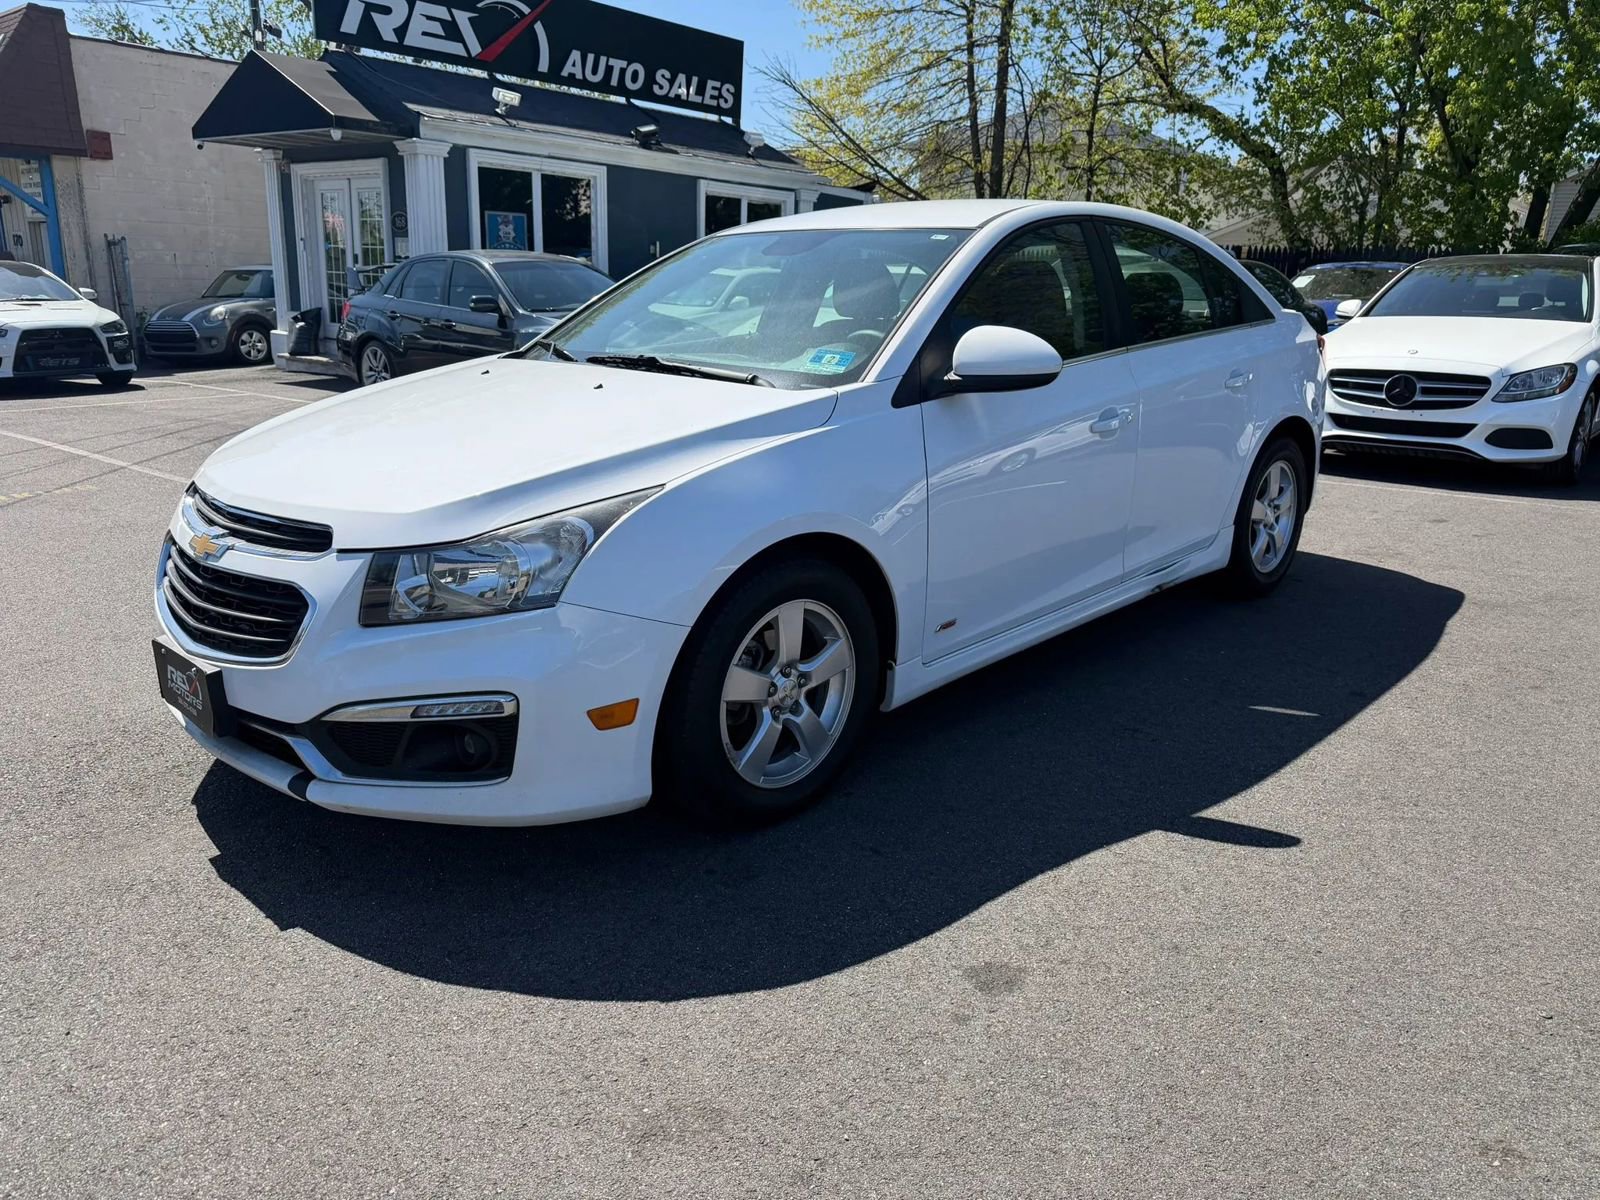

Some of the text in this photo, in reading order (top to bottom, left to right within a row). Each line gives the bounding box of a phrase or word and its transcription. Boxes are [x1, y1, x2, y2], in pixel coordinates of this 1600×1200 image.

[560, 49, 736, 109] AUTO SALES
[167, 680, 203, 710] MOTORS
